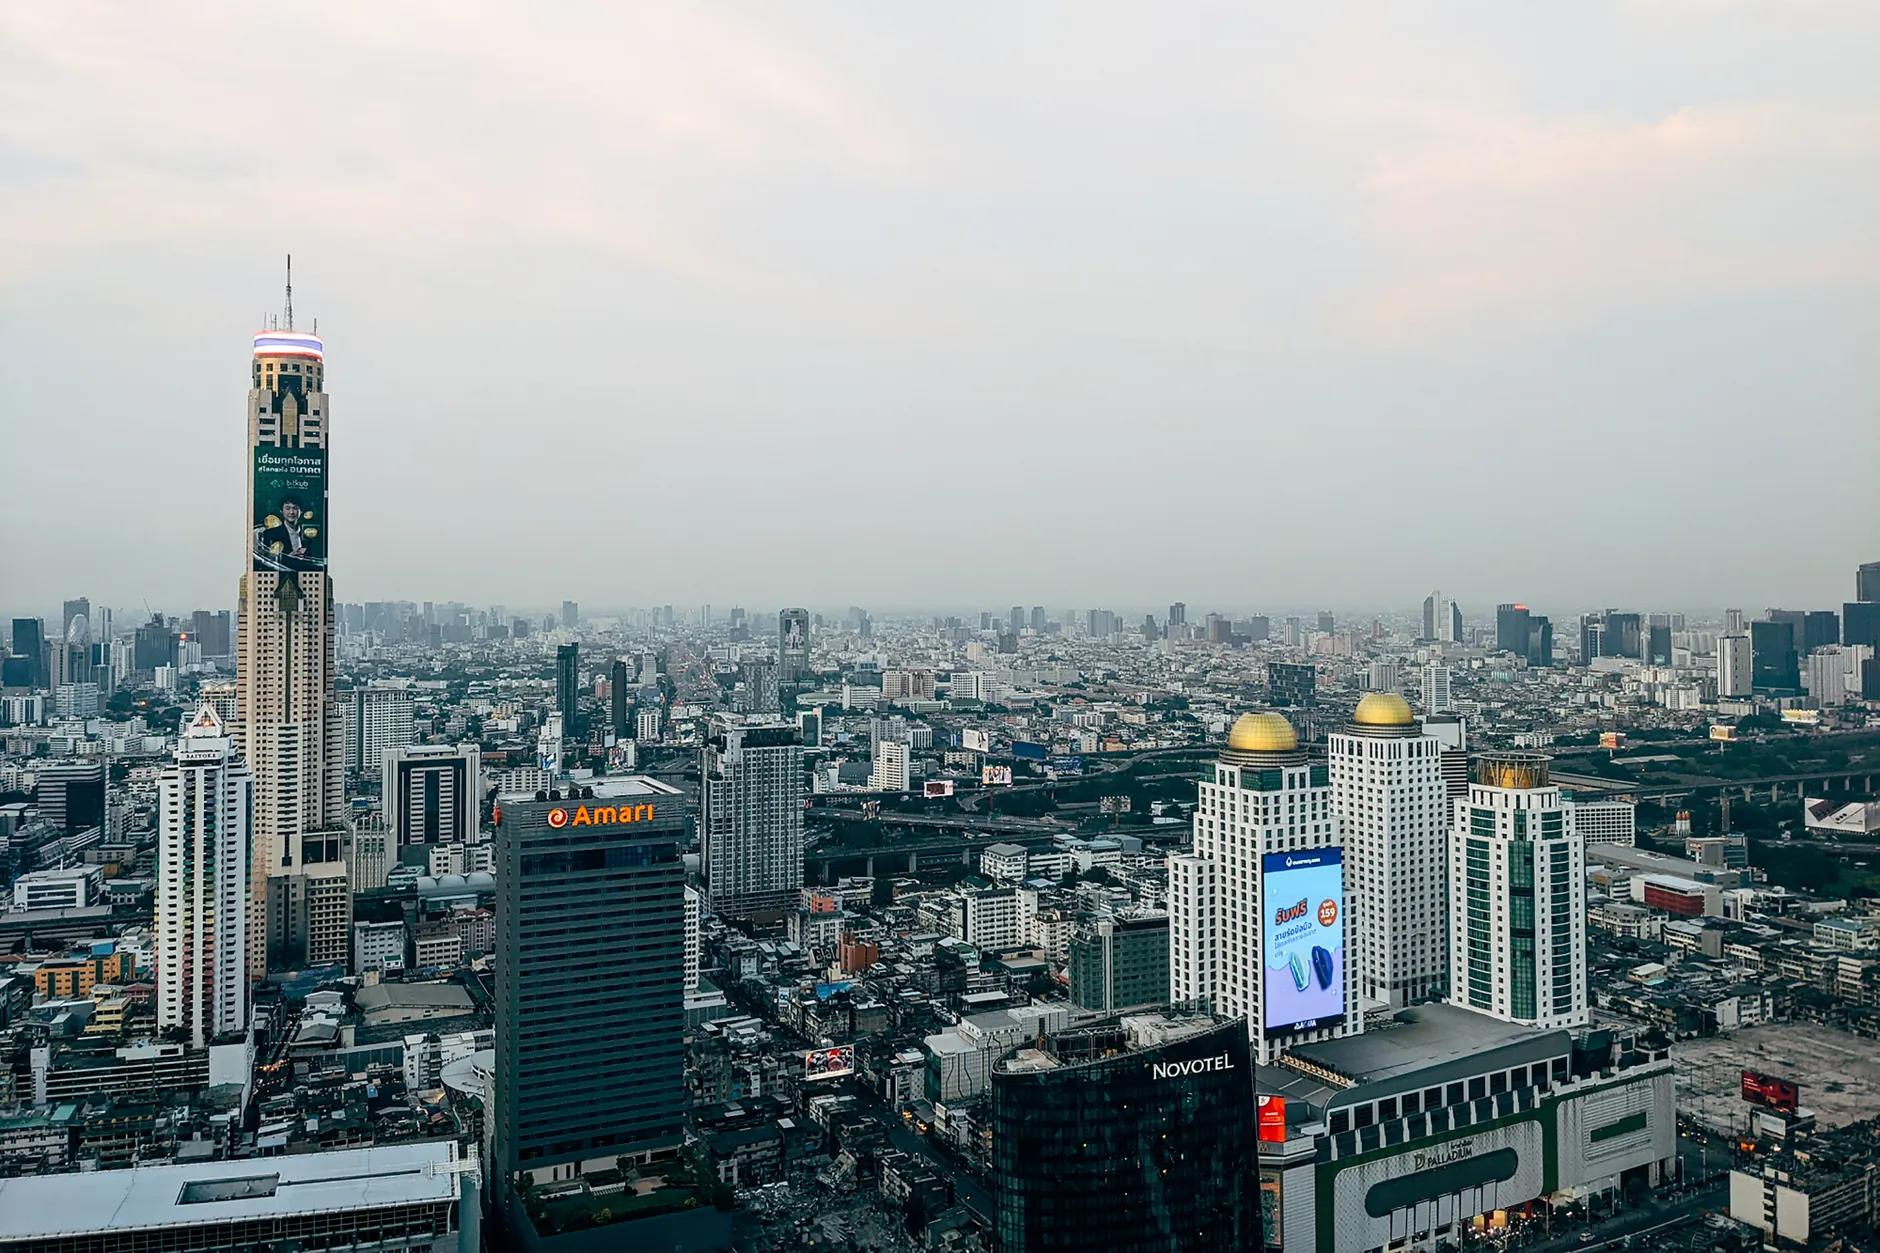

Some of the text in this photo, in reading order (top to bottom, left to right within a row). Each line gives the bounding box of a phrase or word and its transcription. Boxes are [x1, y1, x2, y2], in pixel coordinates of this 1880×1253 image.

[571, 804, 654, 827] Amari
[1275, 898, 1308, 926] รับฟรี
[1320, 907, 1336, 919] 159
[1153, 1053, 1235, 1080] NOVOTEL
[1427, 1147, 1473, 1168] PALLADIUM
